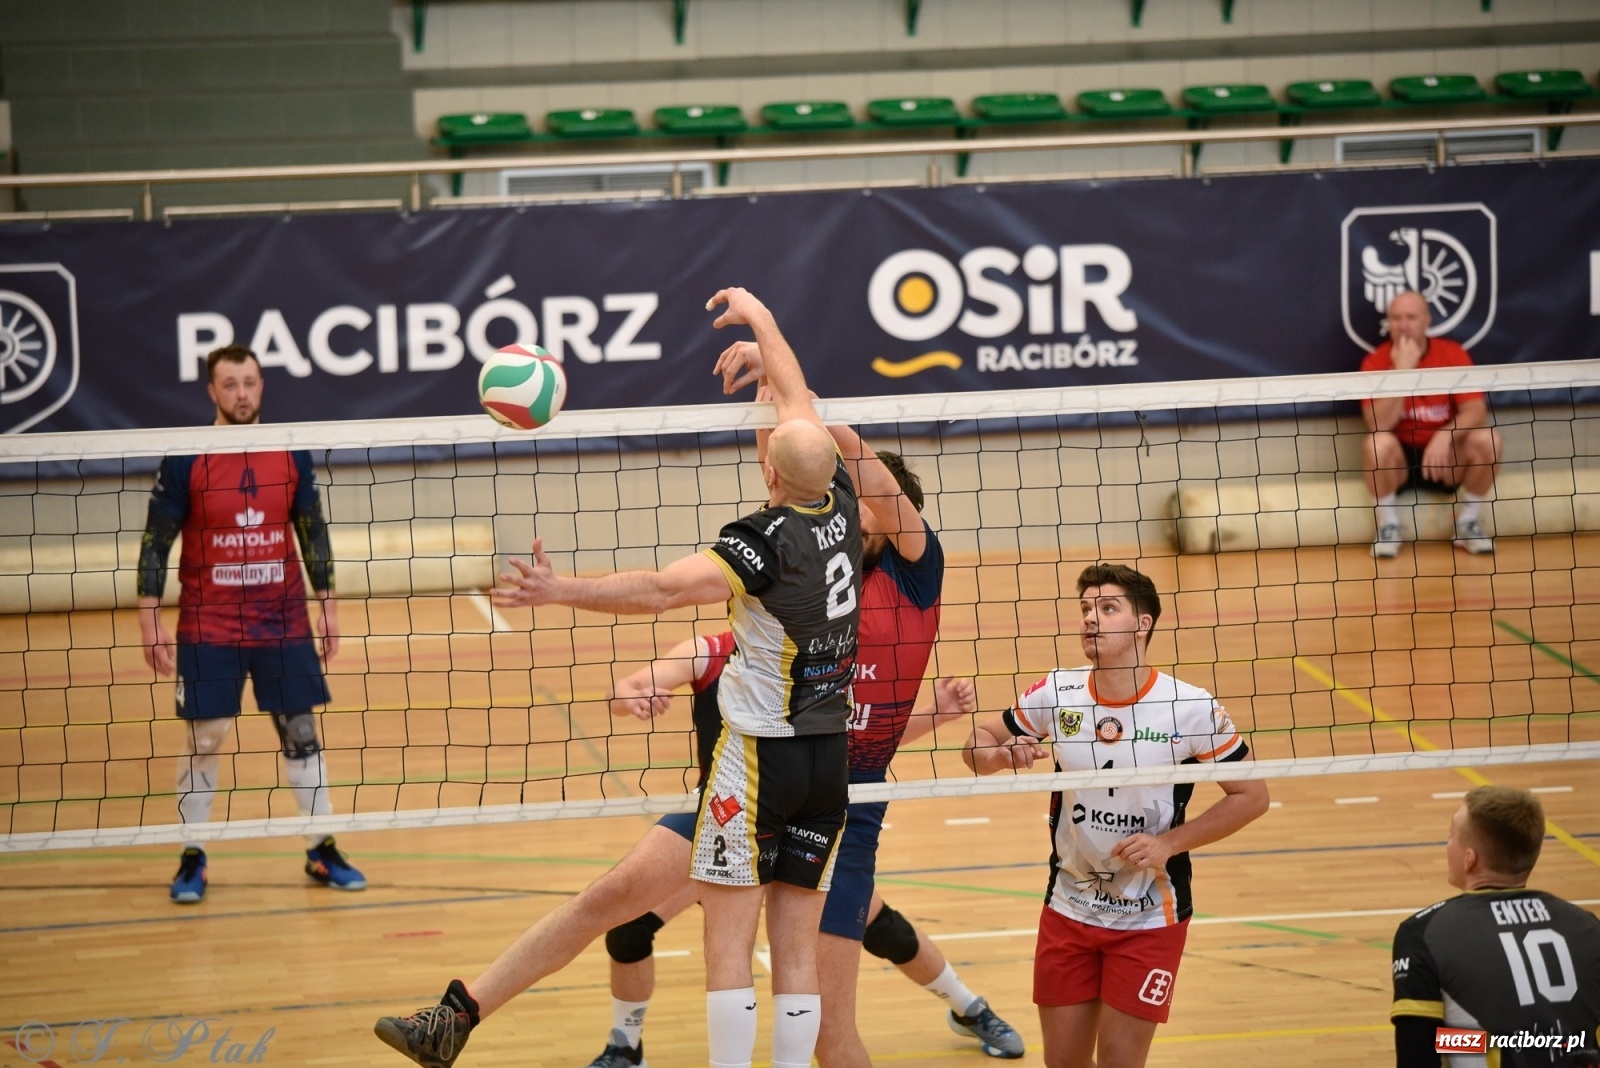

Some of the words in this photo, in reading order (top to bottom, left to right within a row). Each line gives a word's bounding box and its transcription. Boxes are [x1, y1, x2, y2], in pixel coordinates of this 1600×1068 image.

[177, 274, 662, 382] RACIBÓRZ
[976, 335, 1139, 372] RACIBÓRZ
[212, 530, 285, 548] KATOLIK
[214, 561, 284, 584] nowiny.pl
[825, 551, 857, 621] 2
[1134, 727, 1169, 744] plus
[1091, 809, 1145, 828] KGHM
[786, 825, 829, 845] GRAVTON
[713, 835, 728, 867] 2
[1490, 898, 1551, 925] ENTER
[1498, 928, 1578, 1007] 10
